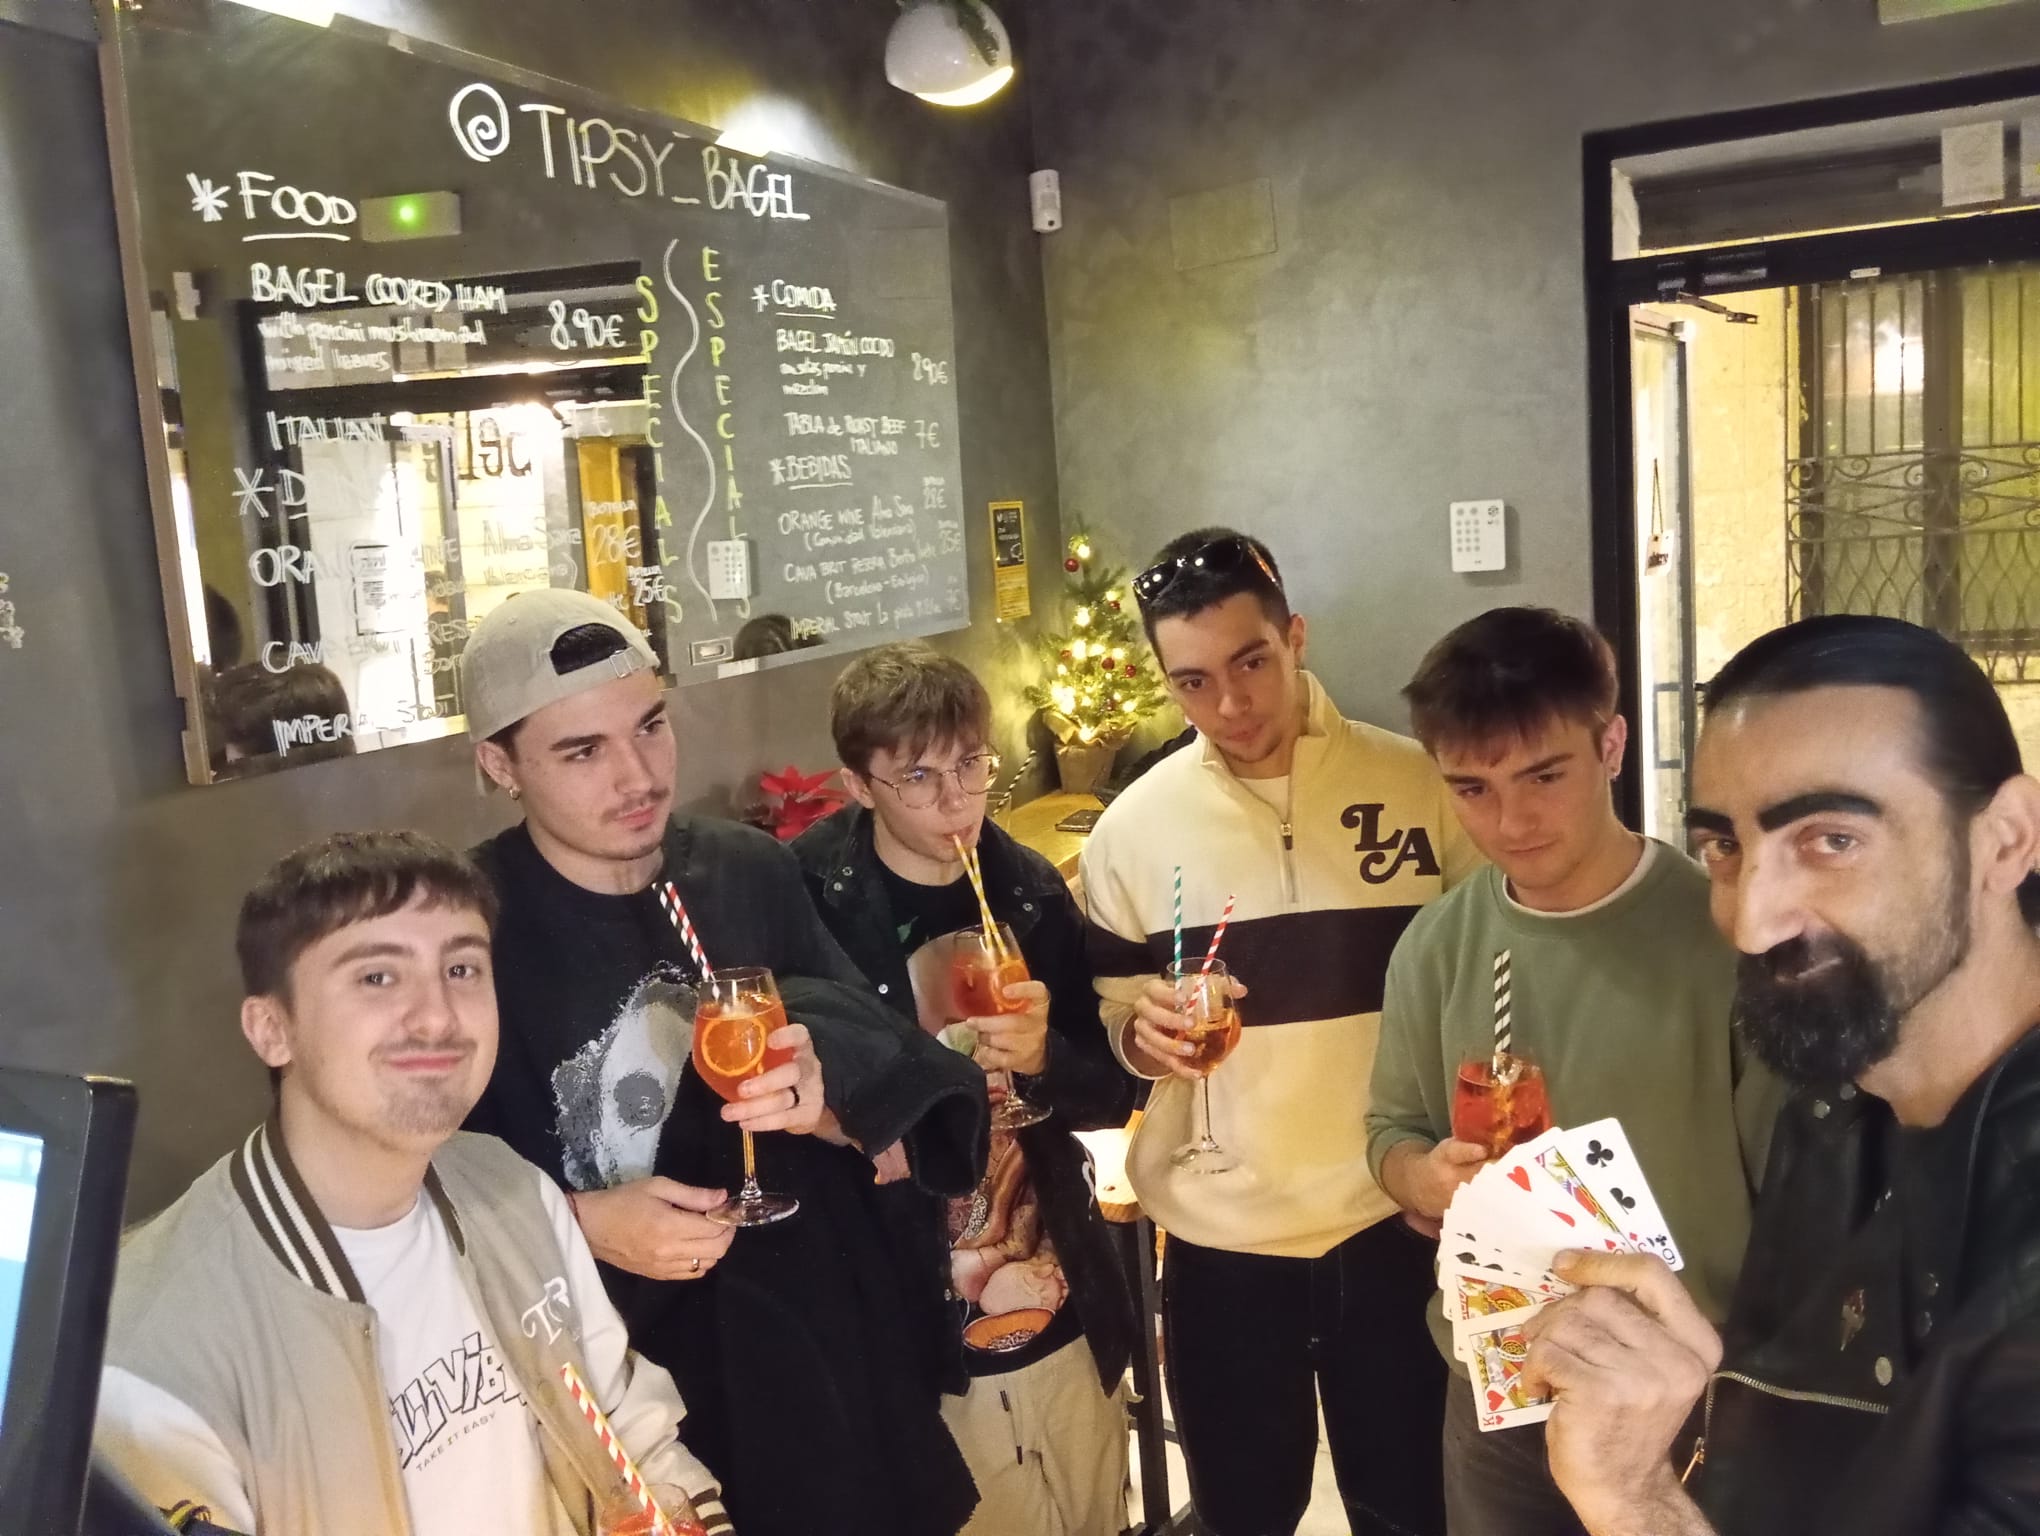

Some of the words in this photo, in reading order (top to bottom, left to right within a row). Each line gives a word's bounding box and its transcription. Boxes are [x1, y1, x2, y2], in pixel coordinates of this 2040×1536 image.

[250, 262, 359, 306] BAGEL
[366, 274, 452, 311] COOKED
[457, 283, 507, 314] HAM
[776, 328, 823, 353] BAGEL
[267, 411, 384, 450] ITALIAN
[784, 411, 825, 437] TABLA
[826, 416, 845, 436] de
[913, 419, 941, 449] 7€
[635, 275, 685, 624] SPECIALS
[786, 455, 853, 482] BEBIDAS
[777, 509, 834, 535] ORANGE
[837, 508, 865, 526] WINE
[592, 524, 641, 566] 28€
[631, 575, 665, 607] 25€
[783, 563, 817, 583] CAVA
[1340, 803, 1441, 884] LA
[1482, 1415, 1495, 1426] K
[415, 1444, 444, 1473] TAKE
[446, 1431, 460, 1447] IT
[463, 1410, 497, 1435] EASY
